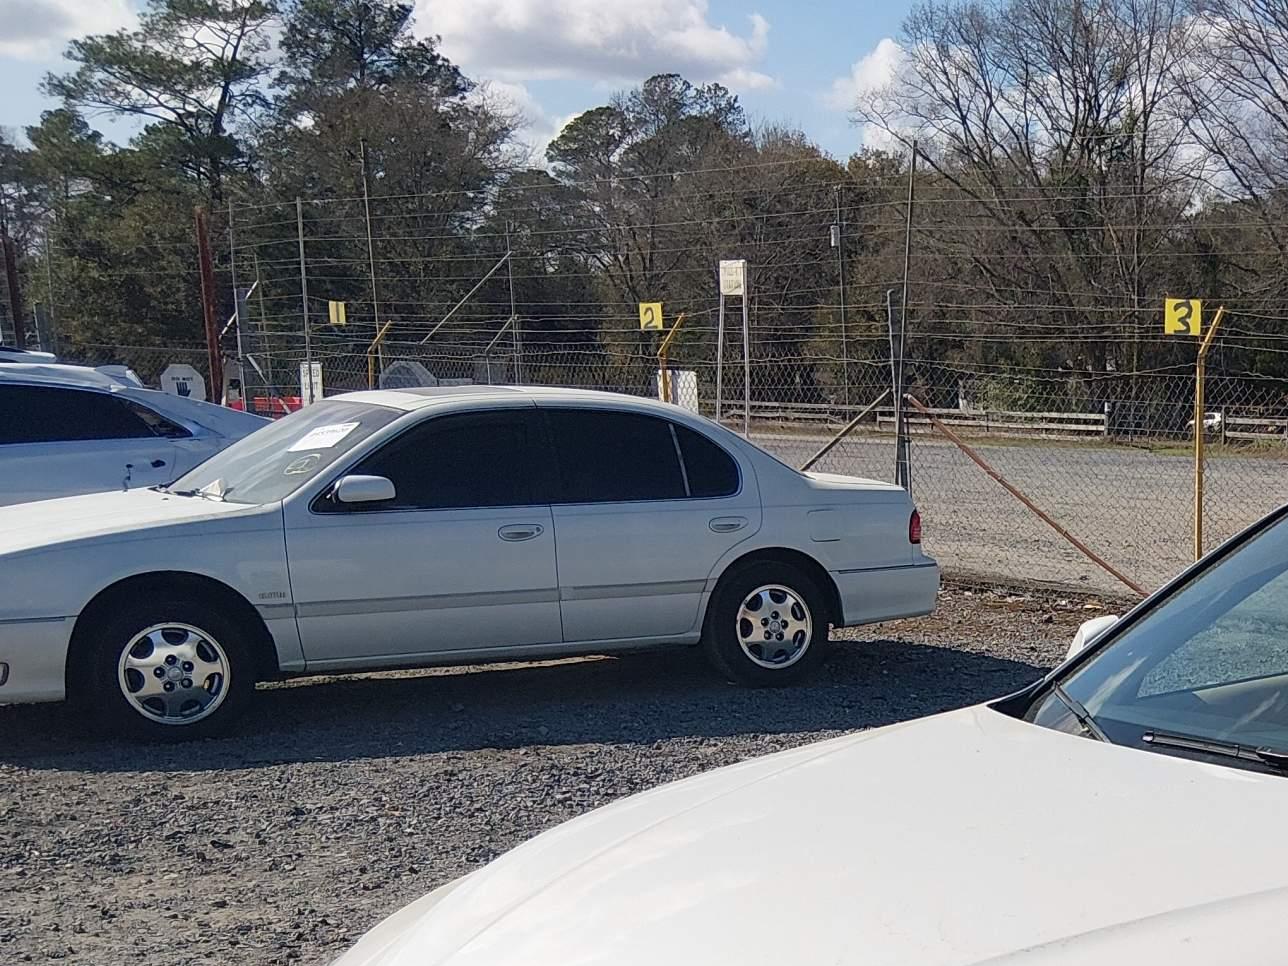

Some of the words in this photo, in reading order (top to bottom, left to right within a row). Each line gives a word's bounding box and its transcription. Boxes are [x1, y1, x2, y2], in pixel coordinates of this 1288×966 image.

[643, 306, 658, 329] 2
[1173, 299, 1193, 334] 3
[303, 369, 320, 378] SPED
